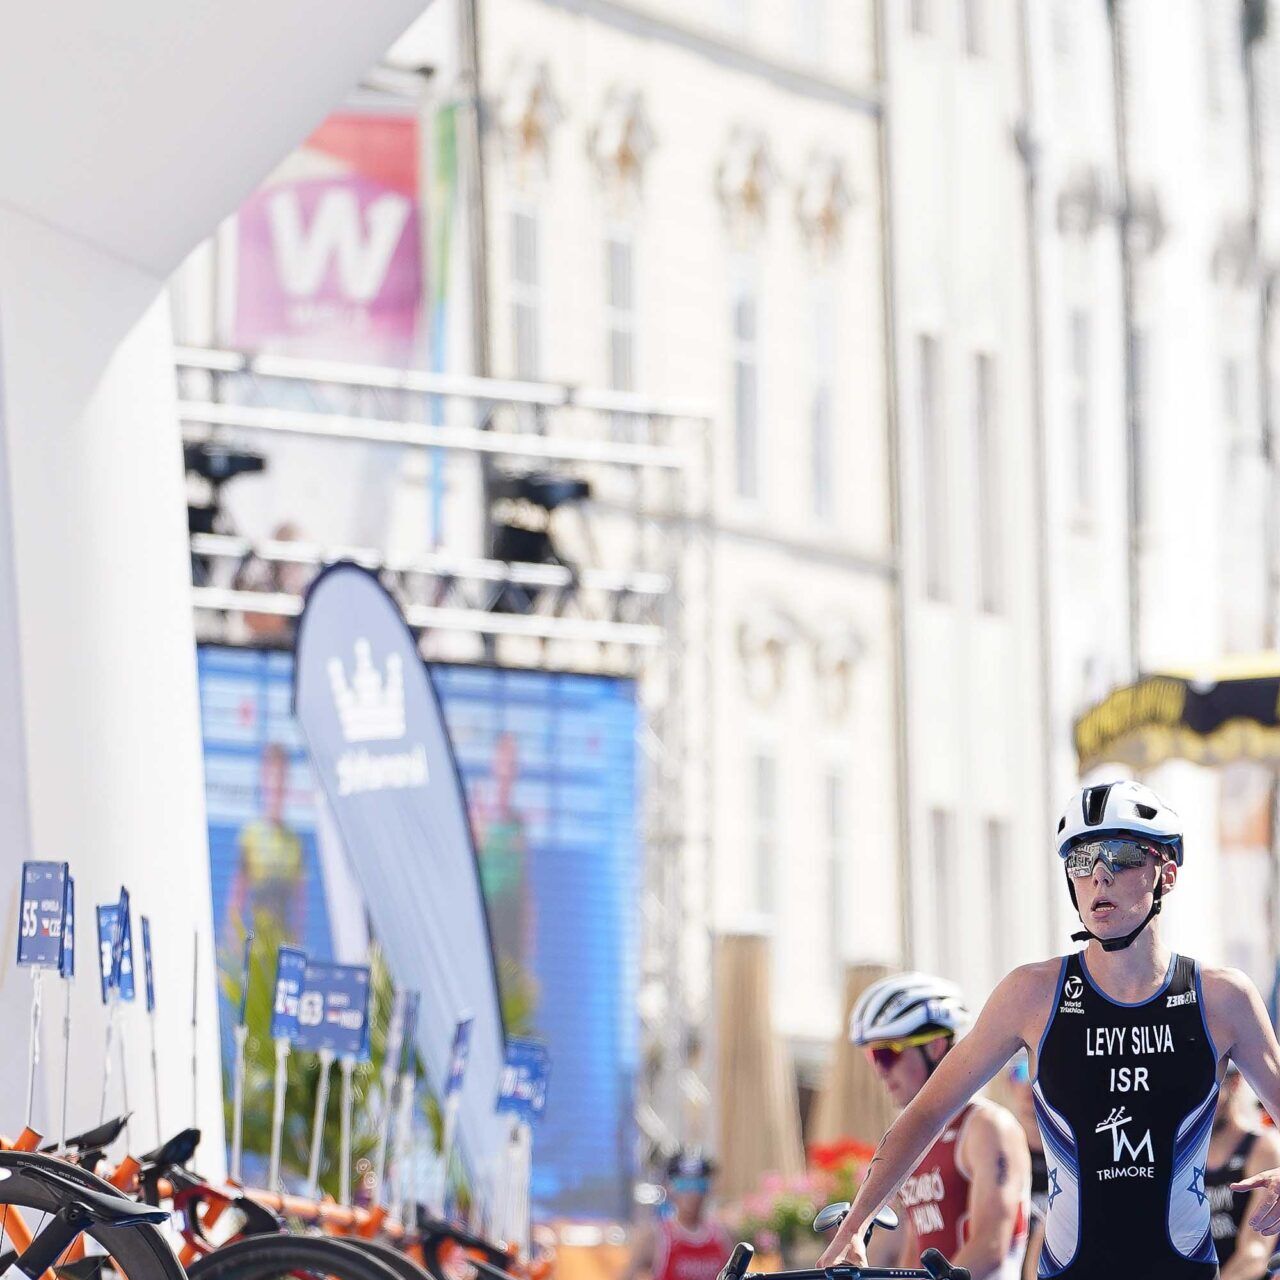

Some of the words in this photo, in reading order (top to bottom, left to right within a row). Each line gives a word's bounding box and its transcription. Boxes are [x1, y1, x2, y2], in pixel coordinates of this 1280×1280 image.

[22, 900, 39, 937] 55
[1060, 1006, 1085, 1014] Triathlon
[1086, 1027, 1126, 1056] LEVY
[1131, 1025, 1175, 1055] SILVA
[1110, 1067, 1150, 1092] ISR
